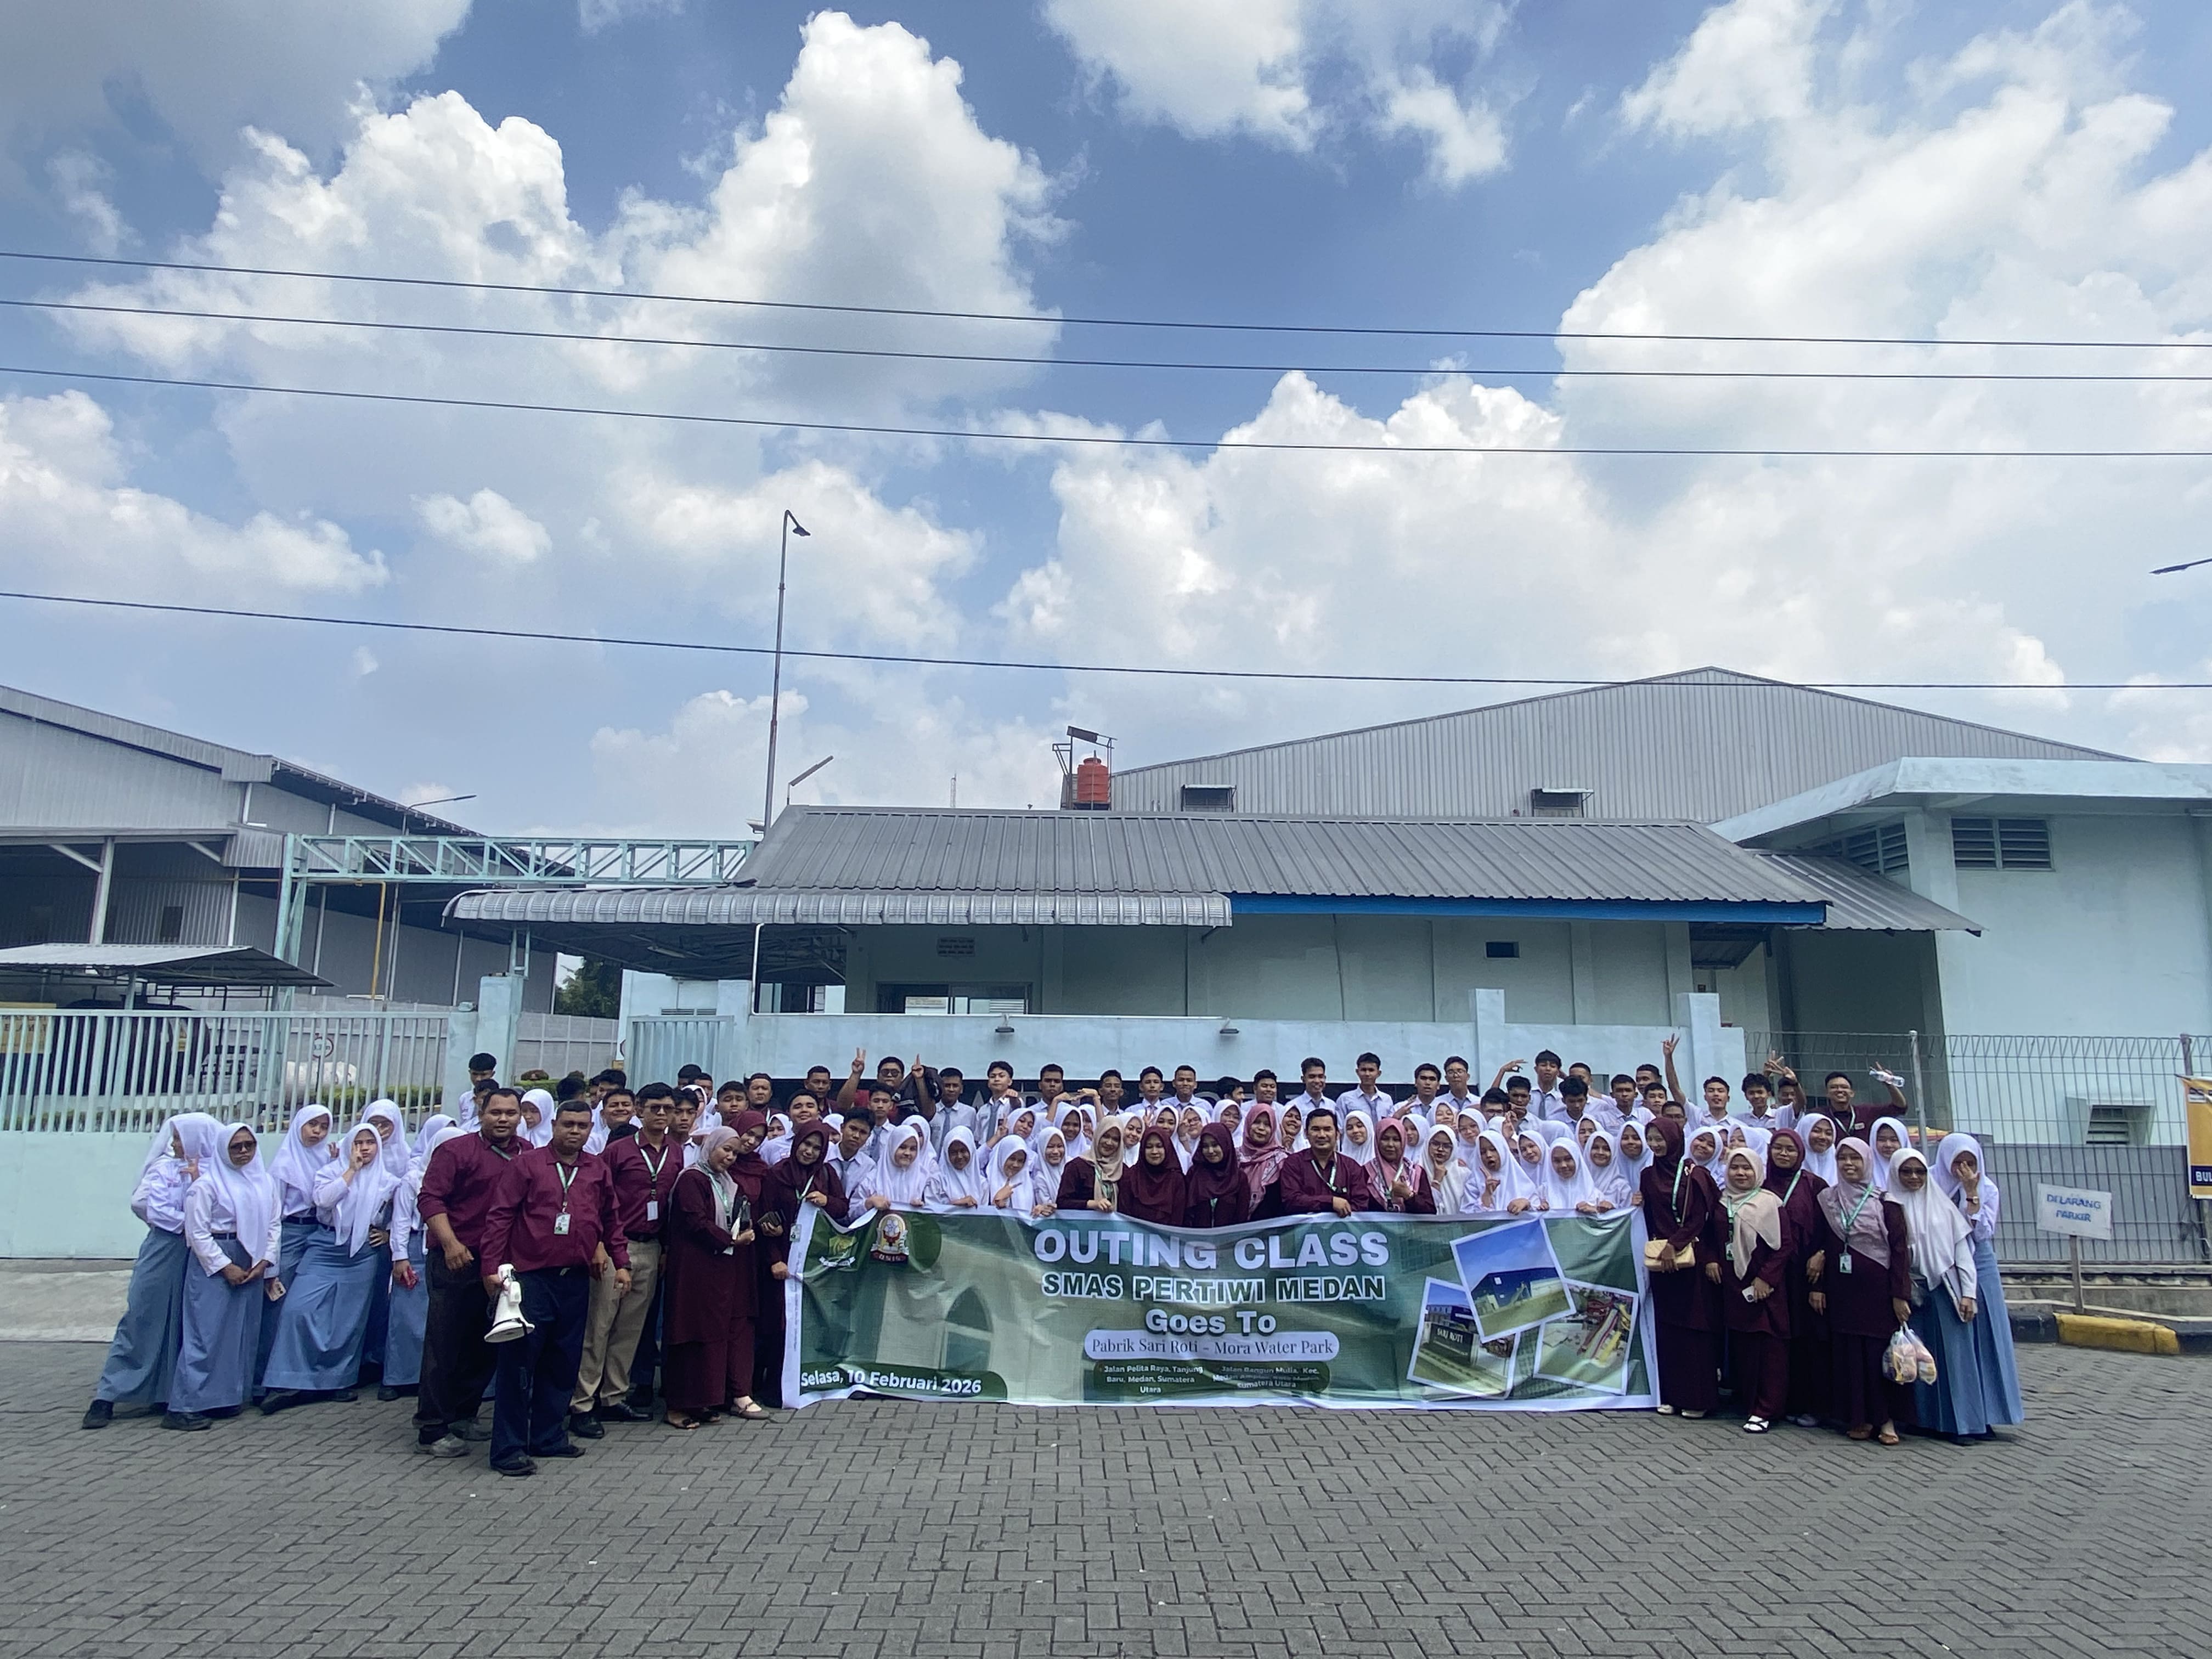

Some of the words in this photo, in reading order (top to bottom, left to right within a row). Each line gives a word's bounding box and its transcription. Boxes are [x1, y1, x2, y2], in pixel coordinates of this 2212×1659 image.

[1034, 1229, 1216, 1269] OUTING
[1234, 1232, 1389, 1269] CLASS
[1042, 1271, 1124, 1300] SMAS
[1133, 1276, 1265, 1304] PERTIWI
[1276, 1276, 1386, 1302] MEDAN
[1146, 1309, 1226, 1335] Goes
[1236, 1311, 1277, 1334] To
[1092, 1339, 1135, 1352] Pabrik
[1139, 1339, 1165, 1352] Sari
[1171, 1340, 1198, 1353] Roti
[1215, 1341, 1251, 1355] Mora
[1255, 1341, 1297, 1355] Water
[1301, 1339, 1333, 1353] Park
[1127, 1364, 1149, 1373] Pelita
[1172, 1365, 1203, 1374] Tanjung
[801, 1370, 844, 1387] Selasa,
[847, 1370, 865, 1384] 10
[870, 1372, 938, 1390] Februari
[941, 1379, 982, 1393] 2026
